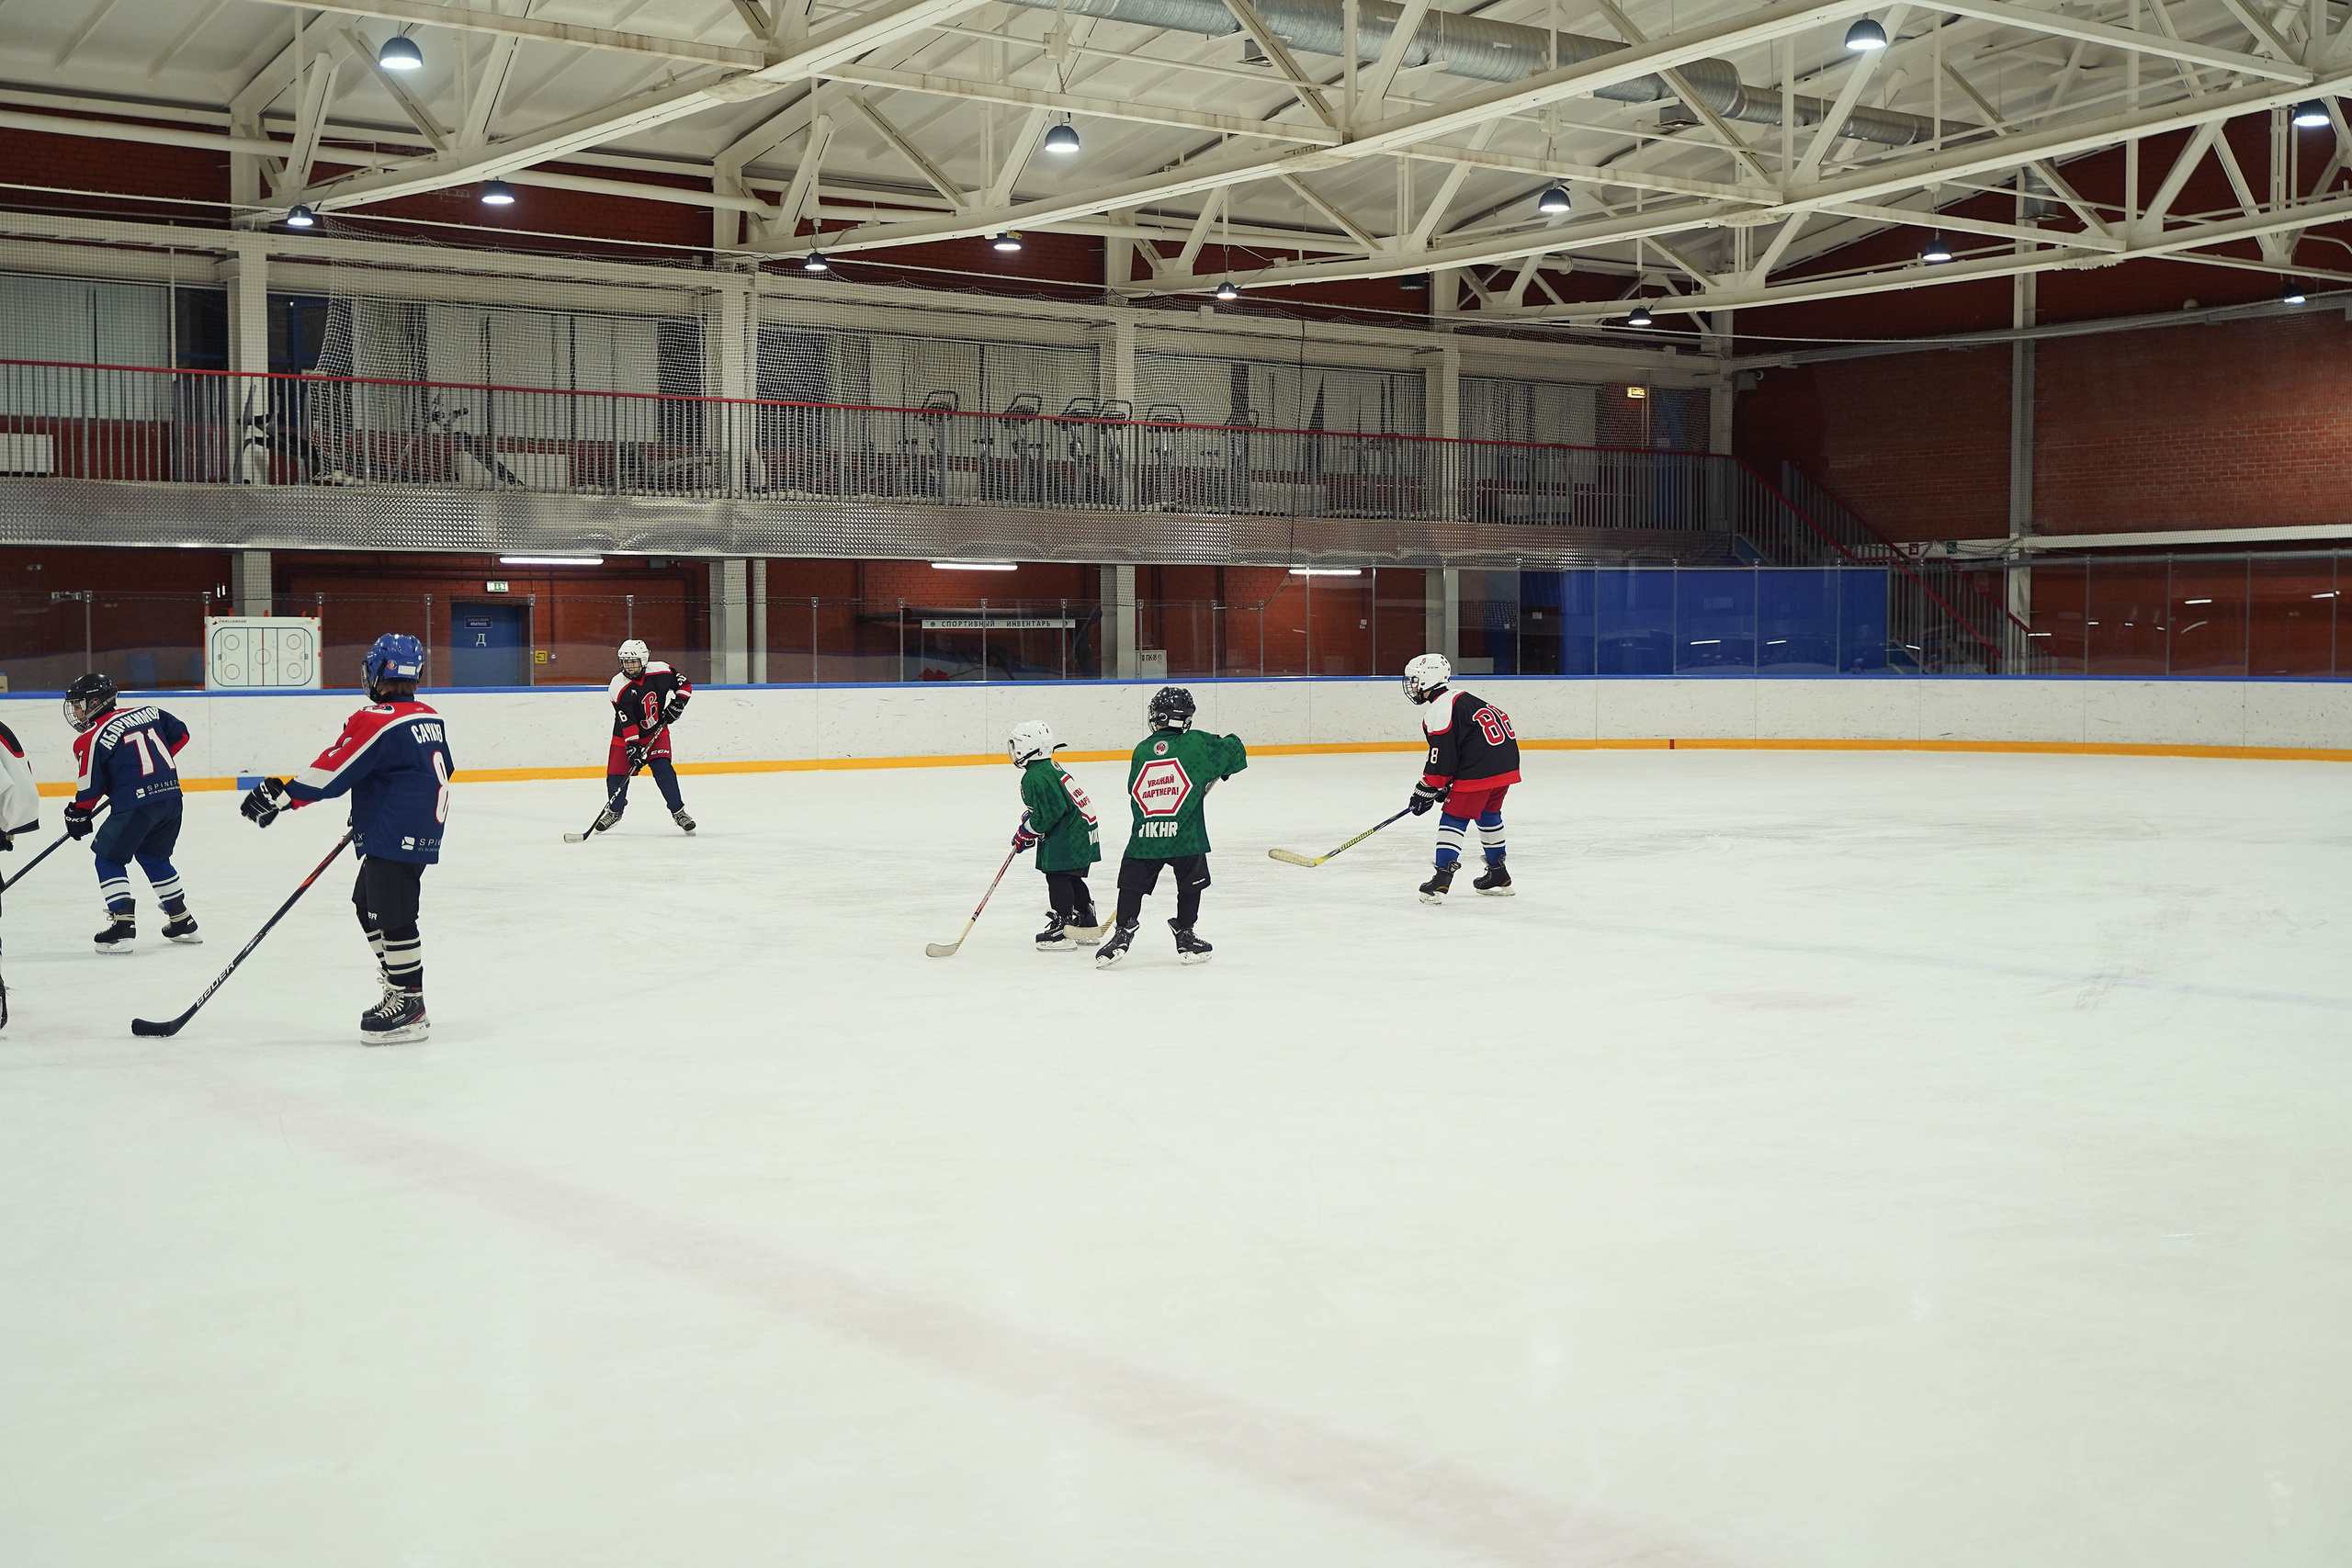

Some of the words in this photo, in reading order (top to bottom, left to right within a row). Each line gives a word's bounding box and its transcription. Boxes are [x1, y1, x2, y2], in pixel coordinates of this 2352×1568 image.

[476, 633, 487, 647] Д
[123, 727, 175, 776] 71
[1428, 748, 1439, 764] 8
[1148, 773, 1174, 788] УВАЖАЙ
[1142, 786, 1179, 798] ПАРТНЕРА!
